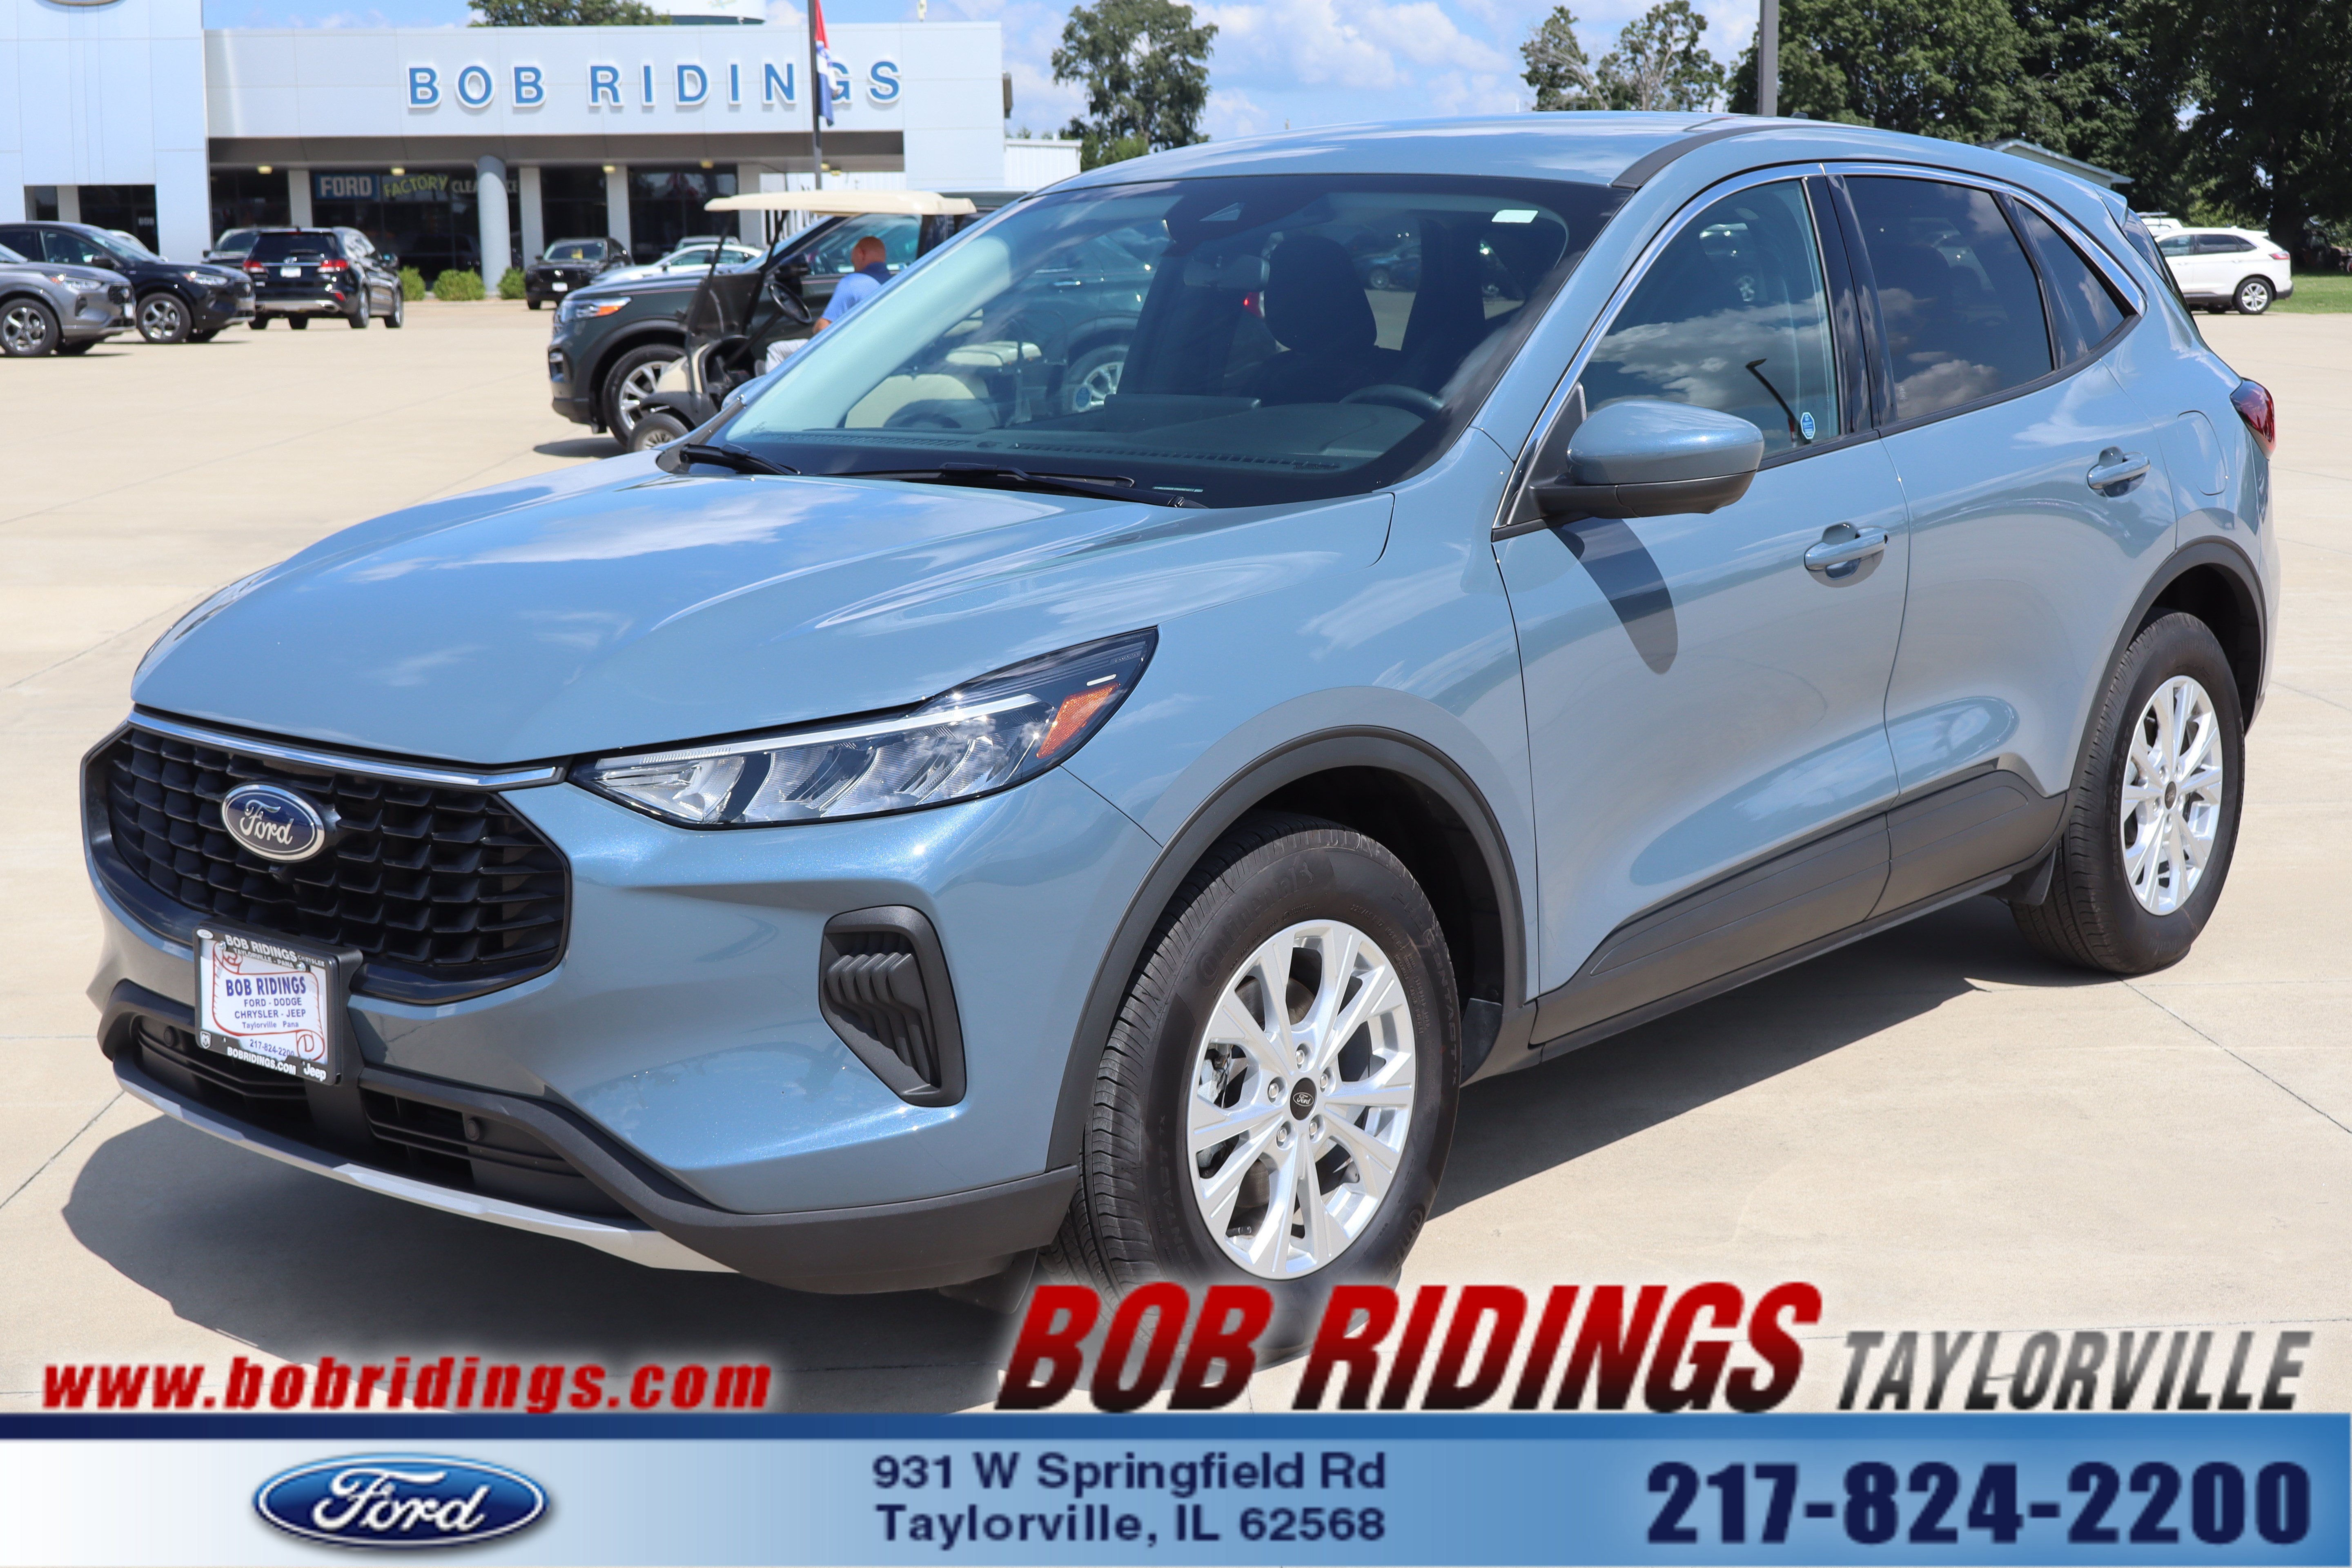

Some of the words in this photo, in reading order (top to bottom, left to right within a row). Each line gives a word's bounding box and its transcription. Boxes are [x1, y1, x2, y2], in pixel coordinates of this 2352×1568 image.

[409, 65, 546, 106] BOB
[590, 61, 901, 104] RIDINGS
[321, 176, 372, 197] FORD
[383, 174, 448, 197] FACTORY
[452, 180, 519, 194] CLEACE
[240, 799, 294, 844] Ford
[225, 934, 249, 950] BOB
[251, 941, 297, 962] RIDINGS
[233, 948, 272, 963] TAYLORVILLE
[277, 959, 294, 969] PANA
[298, 955, 325, 967] CHRYSLER
[226, 979, 252, 996] BOB
[257, 976, 306, 996] RIDINGS
[244, 999, 266, 1007] FORD
[274, 998, 302, 1006] DODGE
[234, 1009, 278, 1019] CHRYSLER
[286, 1009, 306, 1018] JEEP
[242, 1022, 277, 1030] Taylorville
[227, 1046, 296, 1075] BOBRIDINGS.COM
[303, 1062, 326, 1082] Jeep
[1296, 1094, 1311, 1105] Ford
